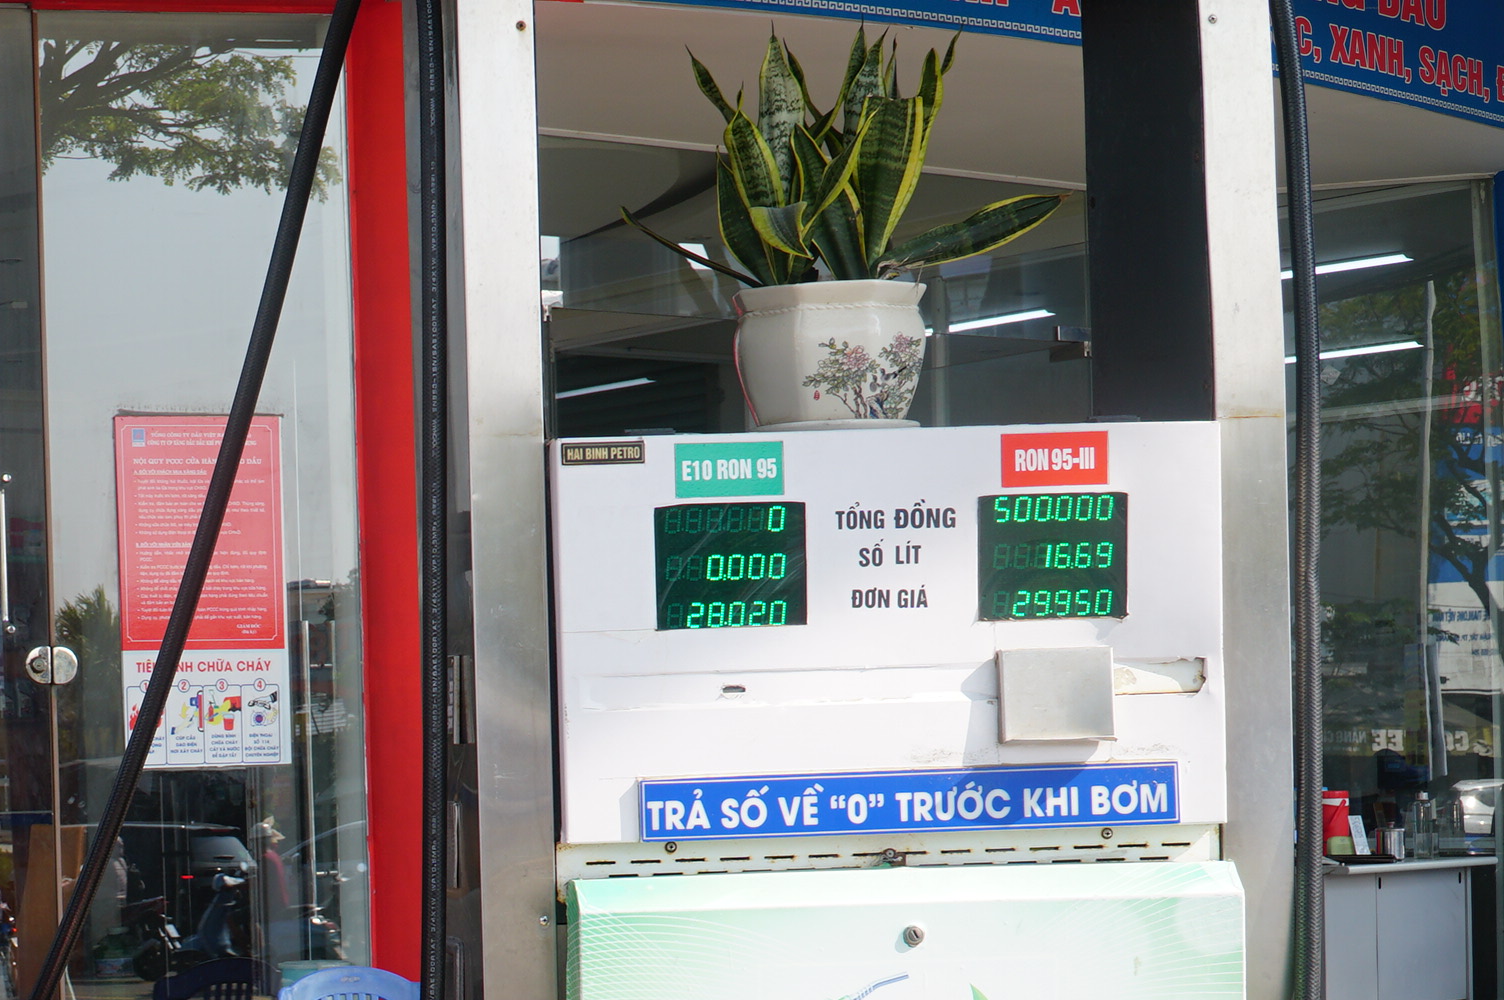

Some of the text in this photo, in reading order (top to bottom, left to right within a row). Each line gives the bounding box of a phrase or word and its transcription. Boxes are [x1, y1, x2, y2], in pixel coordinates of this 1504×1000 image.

[1329, 23, 1412, 84] XANH,
[1418, 46, 1490, 103] SẠCH,
[566, 444, 641, 462] HAI BINH PETRO
[1014, 448, 1095, 472] RON 95-III
[682, 456, 777, 482] E10 RON 95
[767, 505, 786, 532] 0
[835, 499, 957, 531] TỔNG ĐỒNG
[706, 552, 787, 581] 0.000
[858, 540, 922, 567] SỐ LÍT
[851, 585, 929, 608] ĐƠN GIÁ
[136, 659, 155, 673] TIÊ
[198, 658, 232, 672] CHỮA
[237, 657, 271, 671] CHÁY
[181, 681, 186, 690] 2
[219, 681, 225, 690] 3
[257, 680, 262, 689] 4
[647, 787, 710, 832] TRẢ
[721, 781, 768, 829] SỐ
[778, 783, 826, 828] VỀ
[895, 782, 1012, 823] TRƯỚC
[1024, 785, 1080, 817] KHI
[1091, 780, 1168, 815] BƠM
